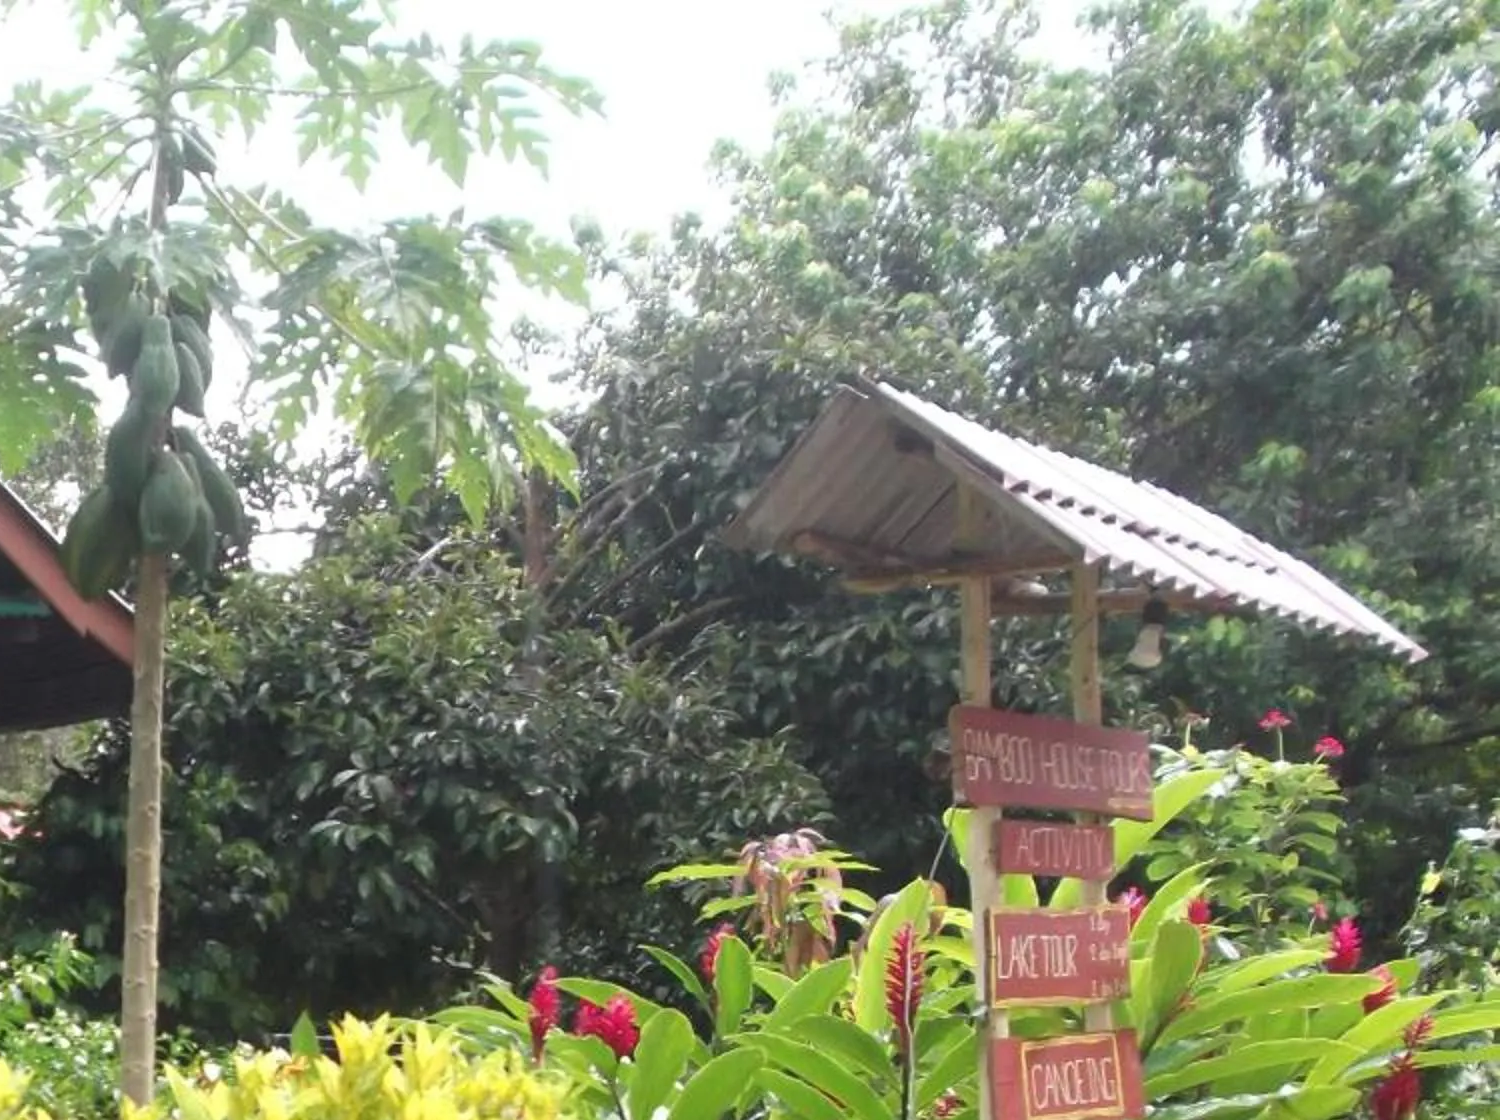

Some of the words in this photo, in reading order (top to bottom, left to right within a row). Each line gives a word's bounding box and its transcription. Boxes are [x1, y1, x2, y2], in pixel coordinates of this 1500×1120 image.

[1041, 741, 1098, 791] HOUSE
[1017, 827, 1111, 876] ACTIVITY
[997, 934, 1039, 979] LAKE
[1040, 934, 1079, 977] TOUR
[1030, 1056, 1117, 1110] CANOEING
